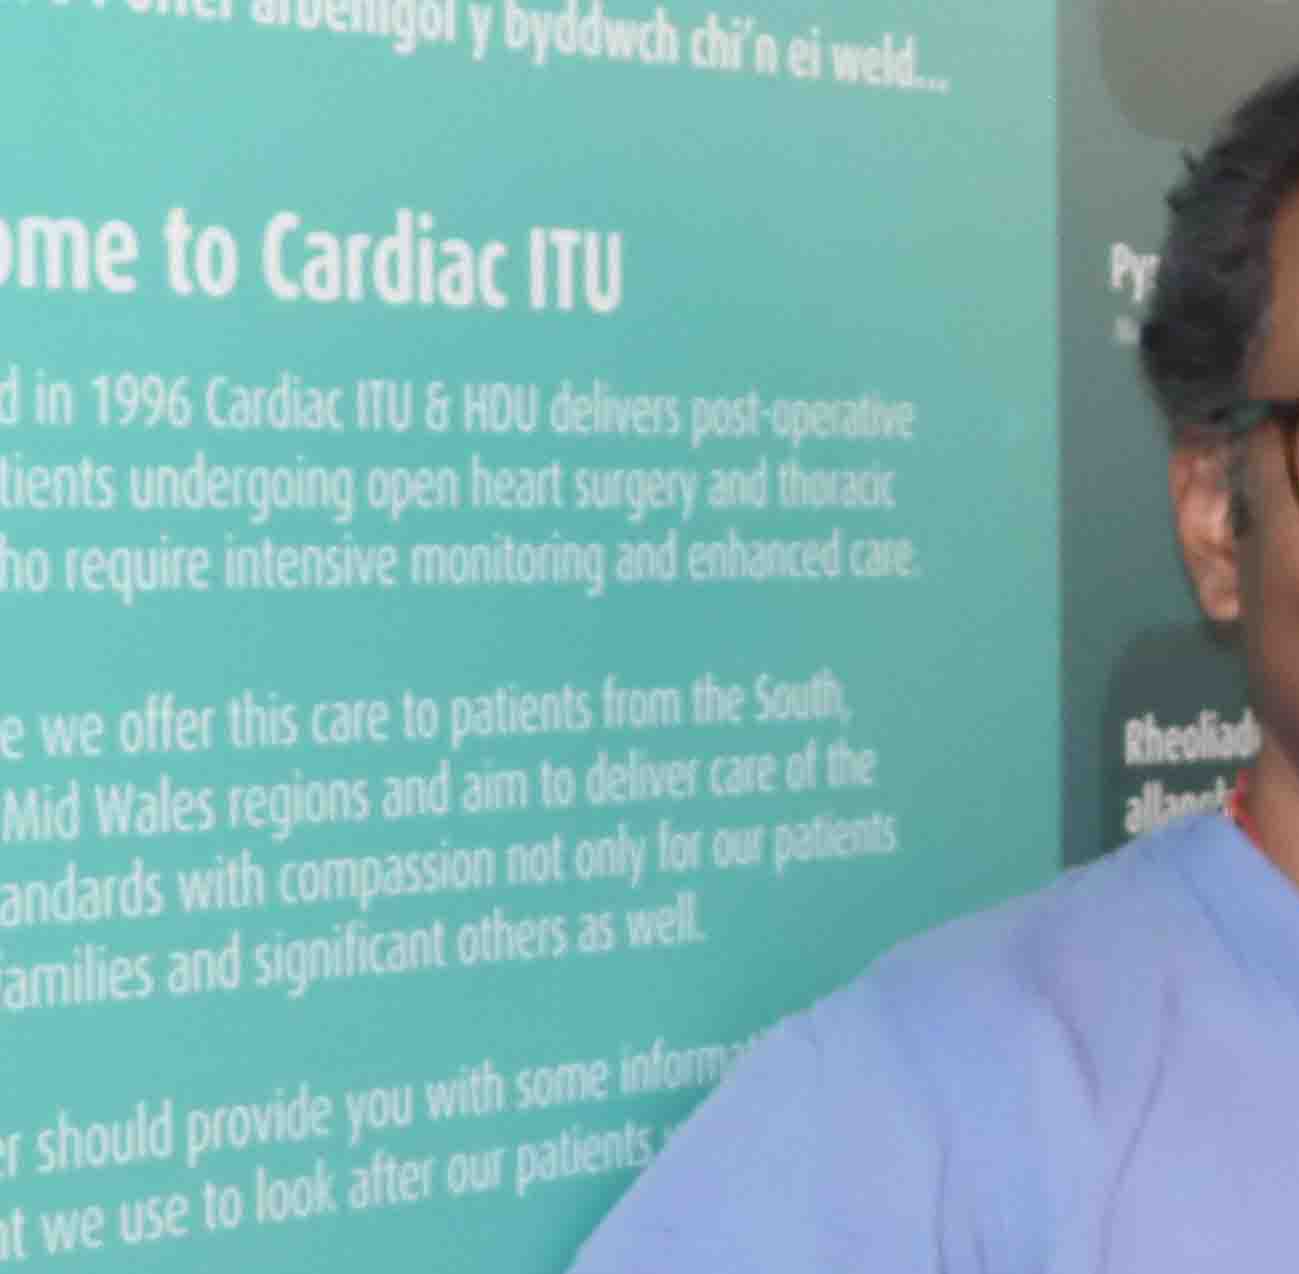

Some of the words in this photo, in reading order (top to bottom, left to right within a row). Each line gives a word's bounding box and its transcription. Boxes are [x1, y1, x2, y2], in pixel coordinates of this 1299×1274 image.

[468, 5, 493, 62] y
[785, 27, 824, 80] ei
[163, 207, 238, 297] to
[262, 208, 508, 309] Cardiac
[530, 226, 623, 313] ITU
[35, 371, 75, 427] in
[92, 371, 192, 428] 1996
[205, 371, 343, 431] Cardiac
[356, 379, 413, 432] ITU
[424, 381, 450, 432] &
[463, 383, 539, 433] HDU
[550, 379, 682, 436] delivers
[691, 389, 916, 448] post-operative
[130, 450, 355, 525] undergoing
[367, 468, 460, 522] open
[471, 454, 562, 508] heart
[575, 469, 698, 523] surgery
[708, 458, 768, 508] and
[777, 460, 896, 509] thoracic
[65, 533, 210, 607] require
[224, 535, 400, 589] intensive
[409, 533, 607, 597] monitoring
[614, 529, 679, 582] and
[687, 528, 842, 582] enhanced
[40, 712, 105, 757] we
[119, 693, 215, 754] offer
[227, 689, 299, 748] this
[311, 699, 391, 745] care
[401, 689, 440, 739] to
[449, 685, 593, 751] patients
[601, 673, 682, 729] from
[691, 673, 745, 724] the
[2, 779, 80, 841] Mid
[95, 773, 216, 835] Wales
[228, 769, 370, 840] regions
[382, 759, 450, 818] and
[462, 769, 529, 812] aim
[540, 760, 575, 806] to
[586, 750, 700, 804] deliver
[709, 752, 777, 796] care
[785, 738, 817, 791] of
[825, 738, 877, 787] the
[178, 849, 265, 912] with
[279, 843, 496, 910] compassion
[506, 836, 562, 884] not
[575, 824, 647, 888] only
[657, 821, 702, 872] for
[712, 825, 766, 868] our
[773, 813, 897, 878] patients
[166, 930, 242, 996] and
[253, 920, 448, 999] significant
[456, 908, 570, 966] others
[576, 912, 617, 953] as
[625, 890, 704, 946] well.
[36, 1098, 174, 1173] should
[186, 1084, 334, 1168] provide
[345, 1086, 414, 1146] you
[425, 1058, 508, 1120] with
[515, 1060, 611, 1110] some
[40, 1205, 105, 1255] we
[118, 1193, 190, 1244] use
[202, 1182, 244, 1232] to
[255, 1159, 337, 1224] look
[348, 1150, 433, 1210] after
[447, 1148, 505, 1196] our
